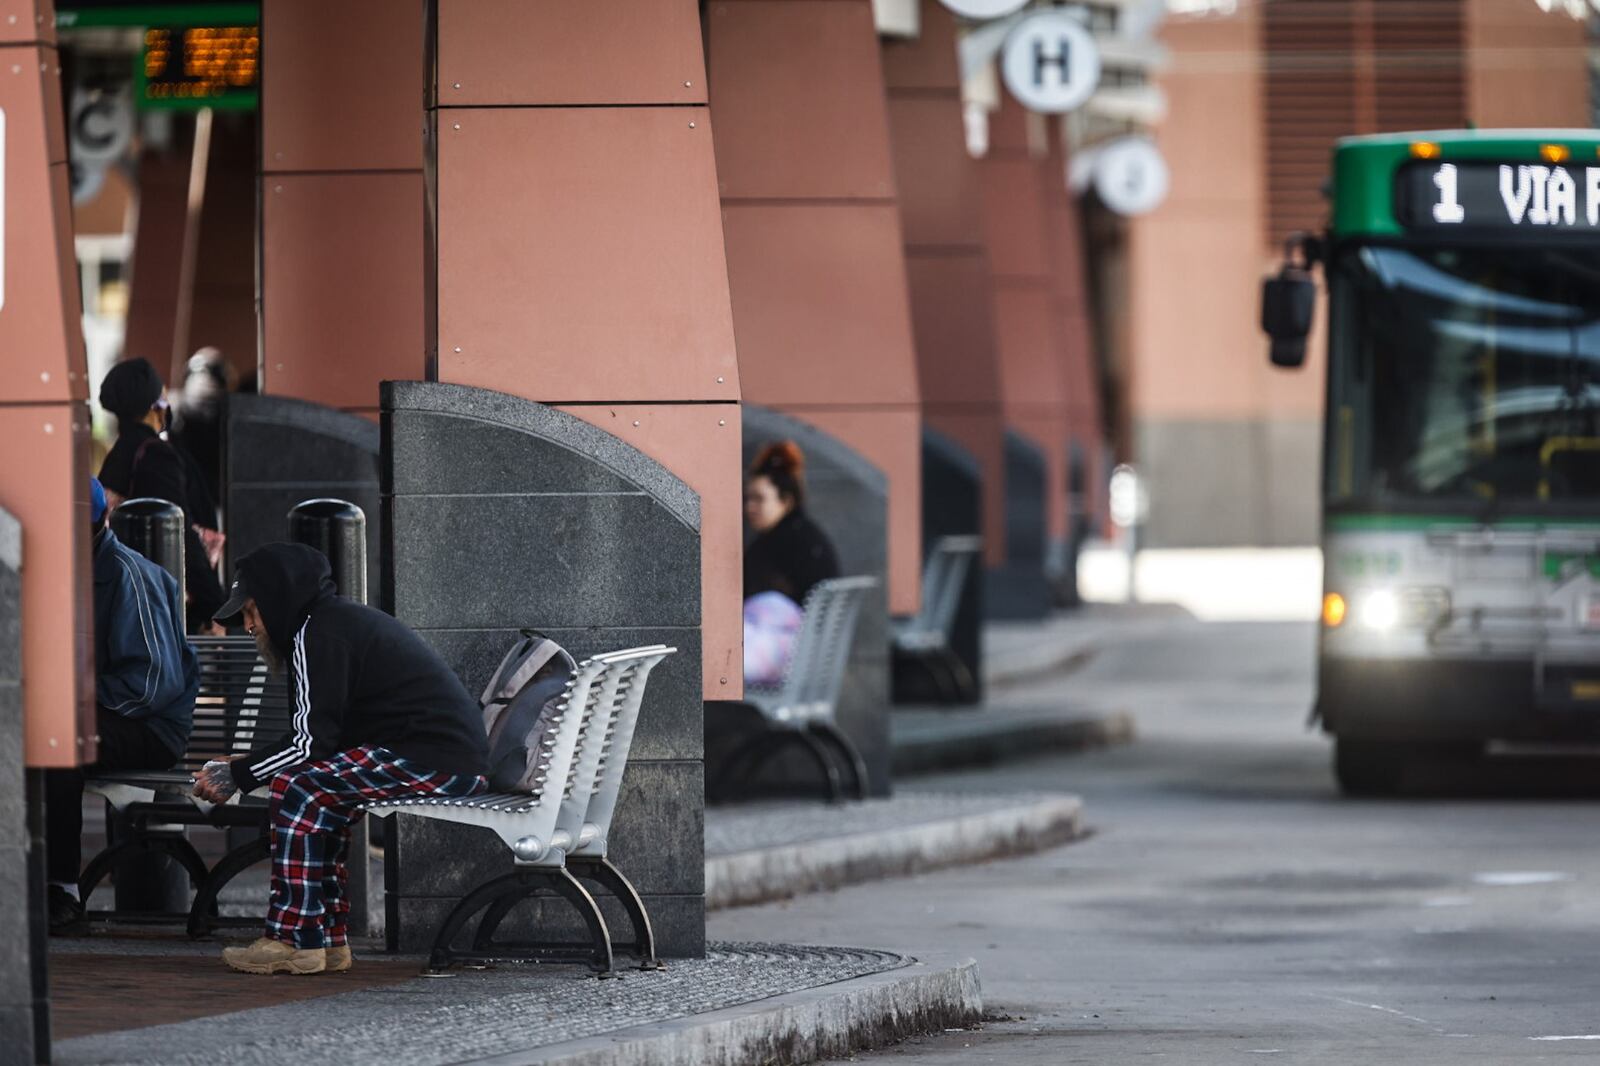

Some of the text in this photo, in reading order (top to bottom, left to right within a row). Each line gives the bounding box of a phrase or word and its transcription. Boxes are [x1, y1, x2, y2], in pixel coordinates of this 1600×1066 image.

[1032, 38, 1070, 86] H
[77, 101, 119, 150] C
[1433, 163, 1464, 223] 1
[1500, 164, 1576, 225] VIA
